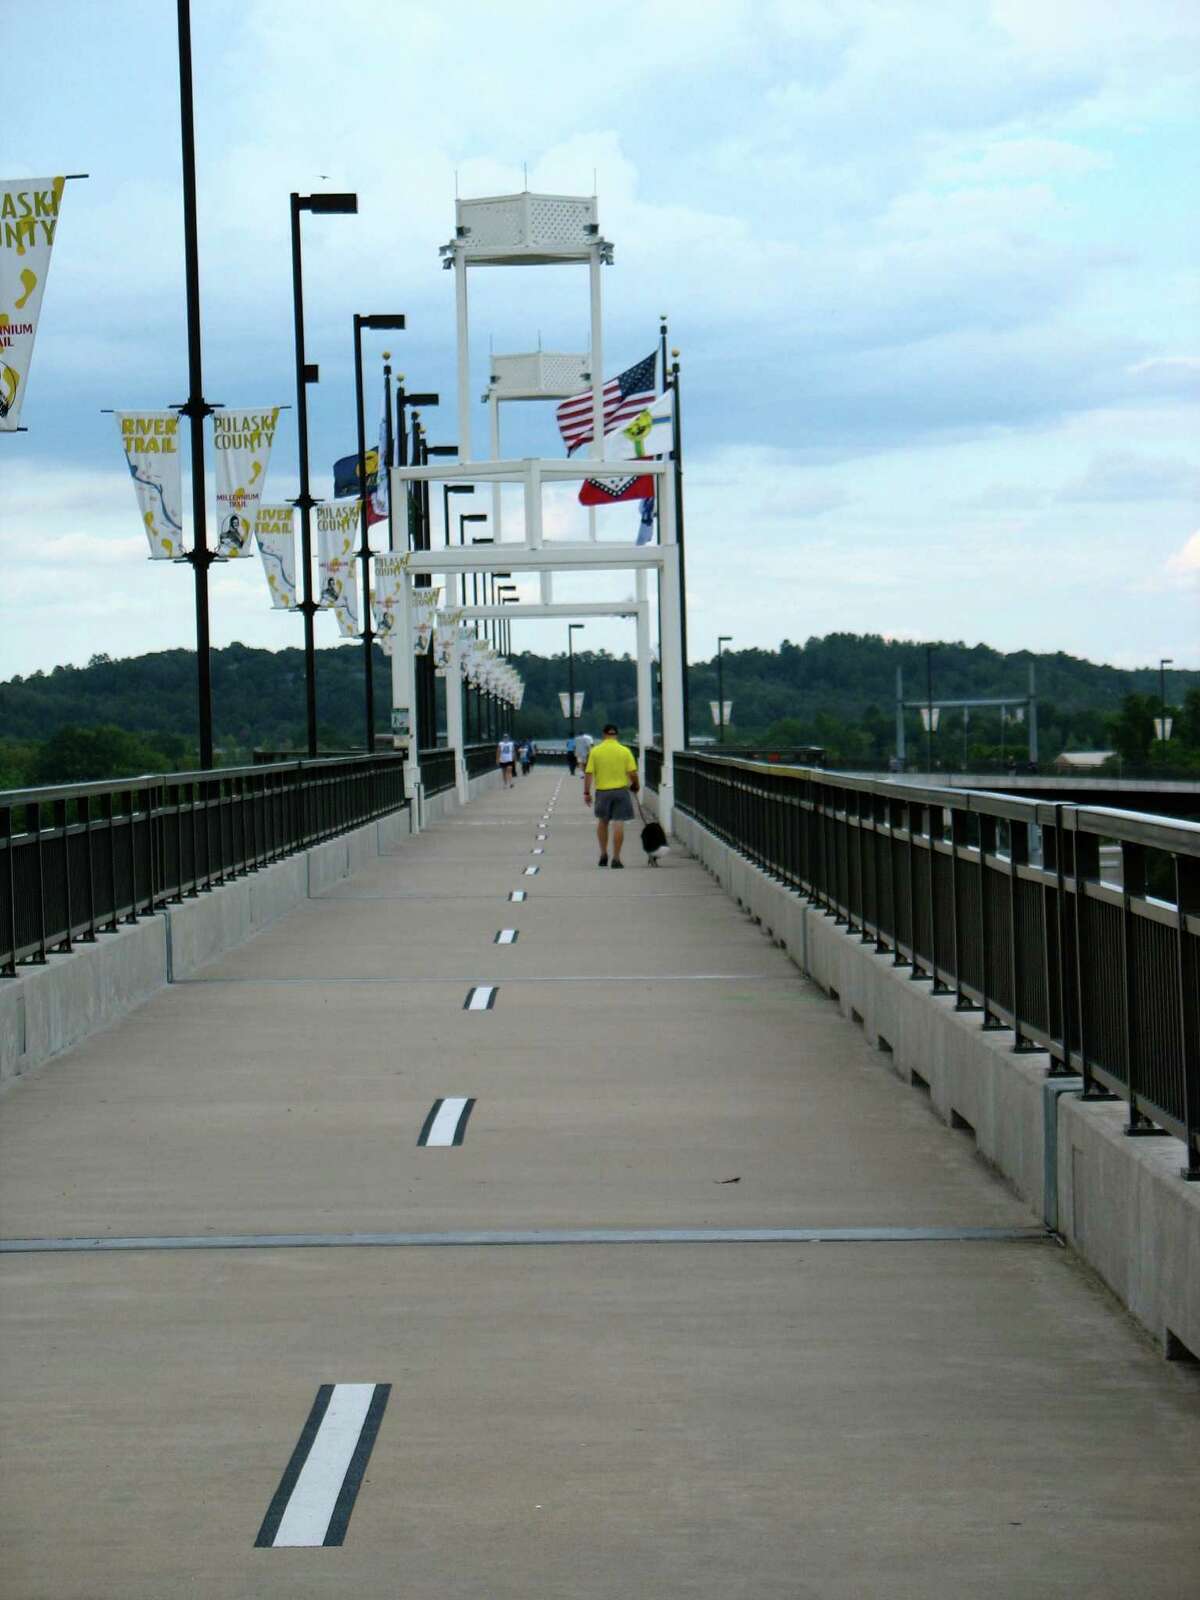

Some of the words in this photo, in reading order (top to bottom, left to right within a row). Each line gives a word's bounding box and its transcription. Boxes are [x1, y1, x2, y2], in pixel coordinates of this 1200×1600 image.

[0, 219, 57, 248] NTY
[122, 418, 177, 434] RIVER
[214, 415, 276, 433] PULASKI
[123, 436, 177, 454] TRAIL
[215, 431, 274, 450] COUNTY
[317, 506, 360, 519] PULASKI
[317, 519, 359, 532] COUNTY
